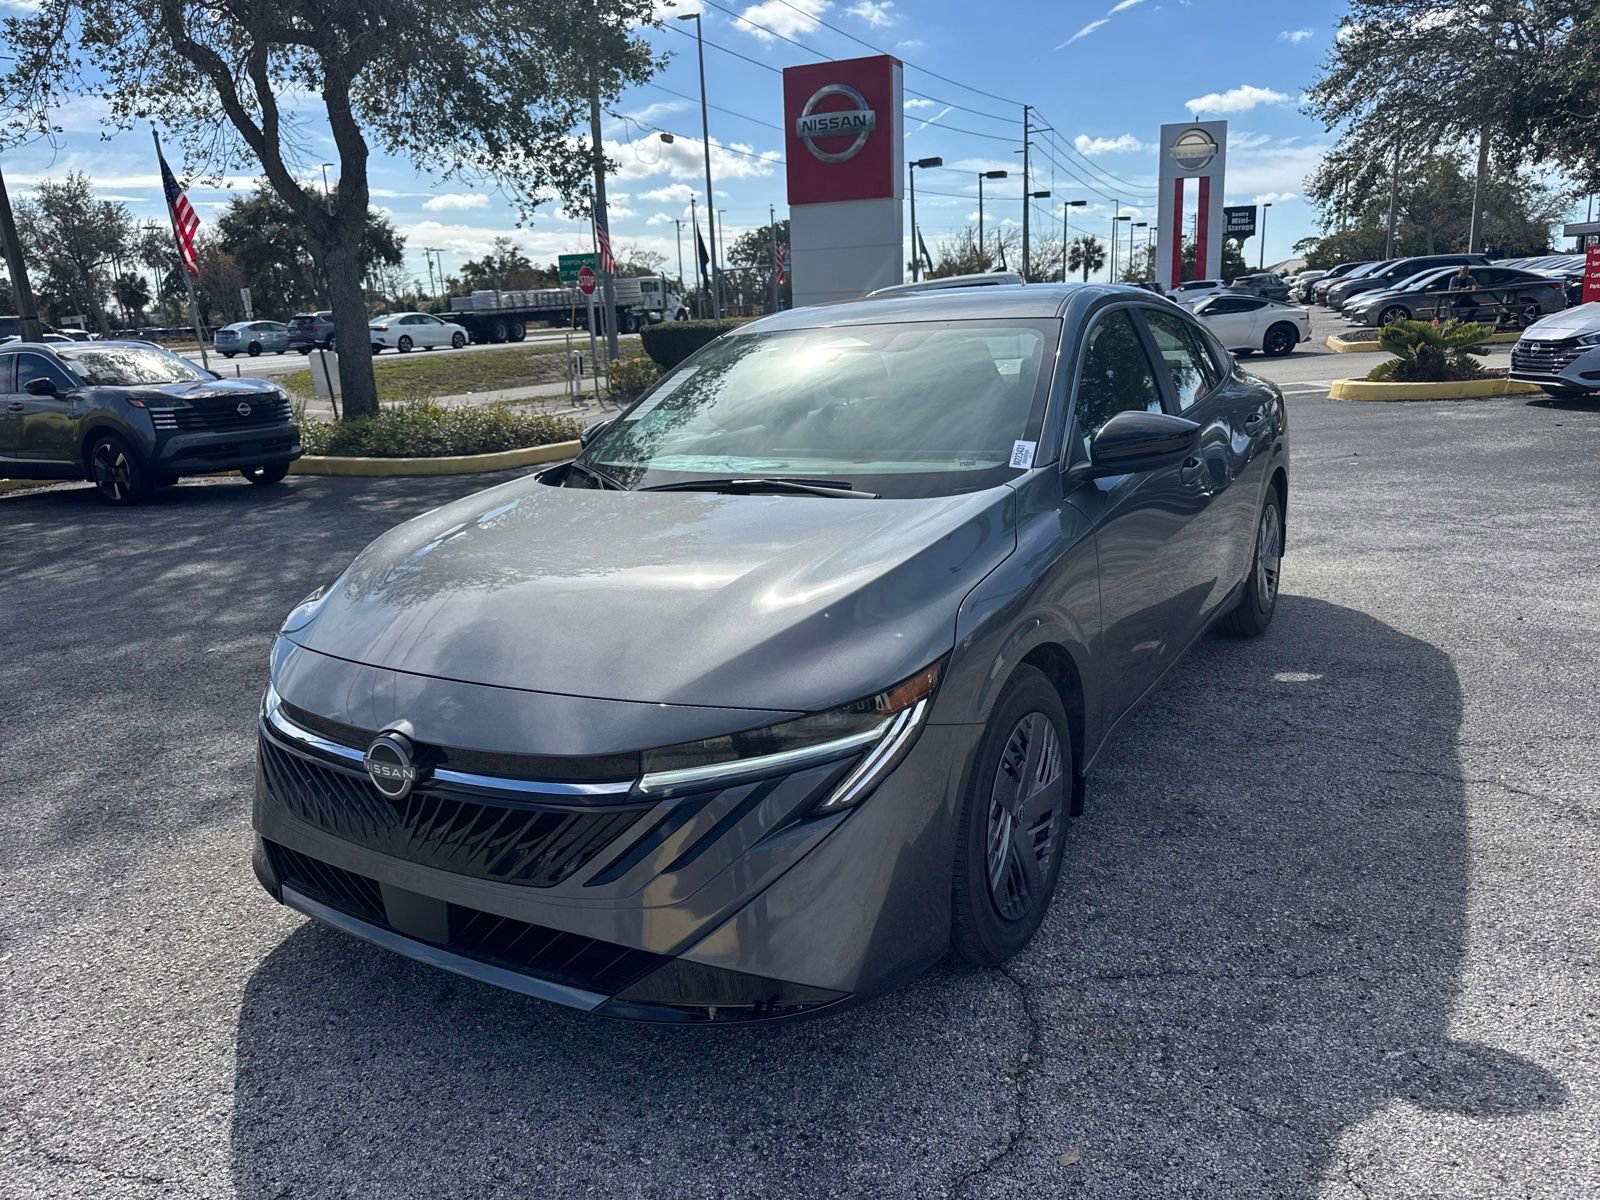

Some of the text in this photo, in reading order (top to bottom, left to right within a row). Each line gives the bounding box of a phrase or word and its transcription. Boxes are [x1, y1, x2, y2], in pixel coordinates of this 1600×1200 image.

[802, 114, 867, 132] NISSAN
[580, 275, 595, 287] STOP
[364, 760, 413, 778] NISSAN
